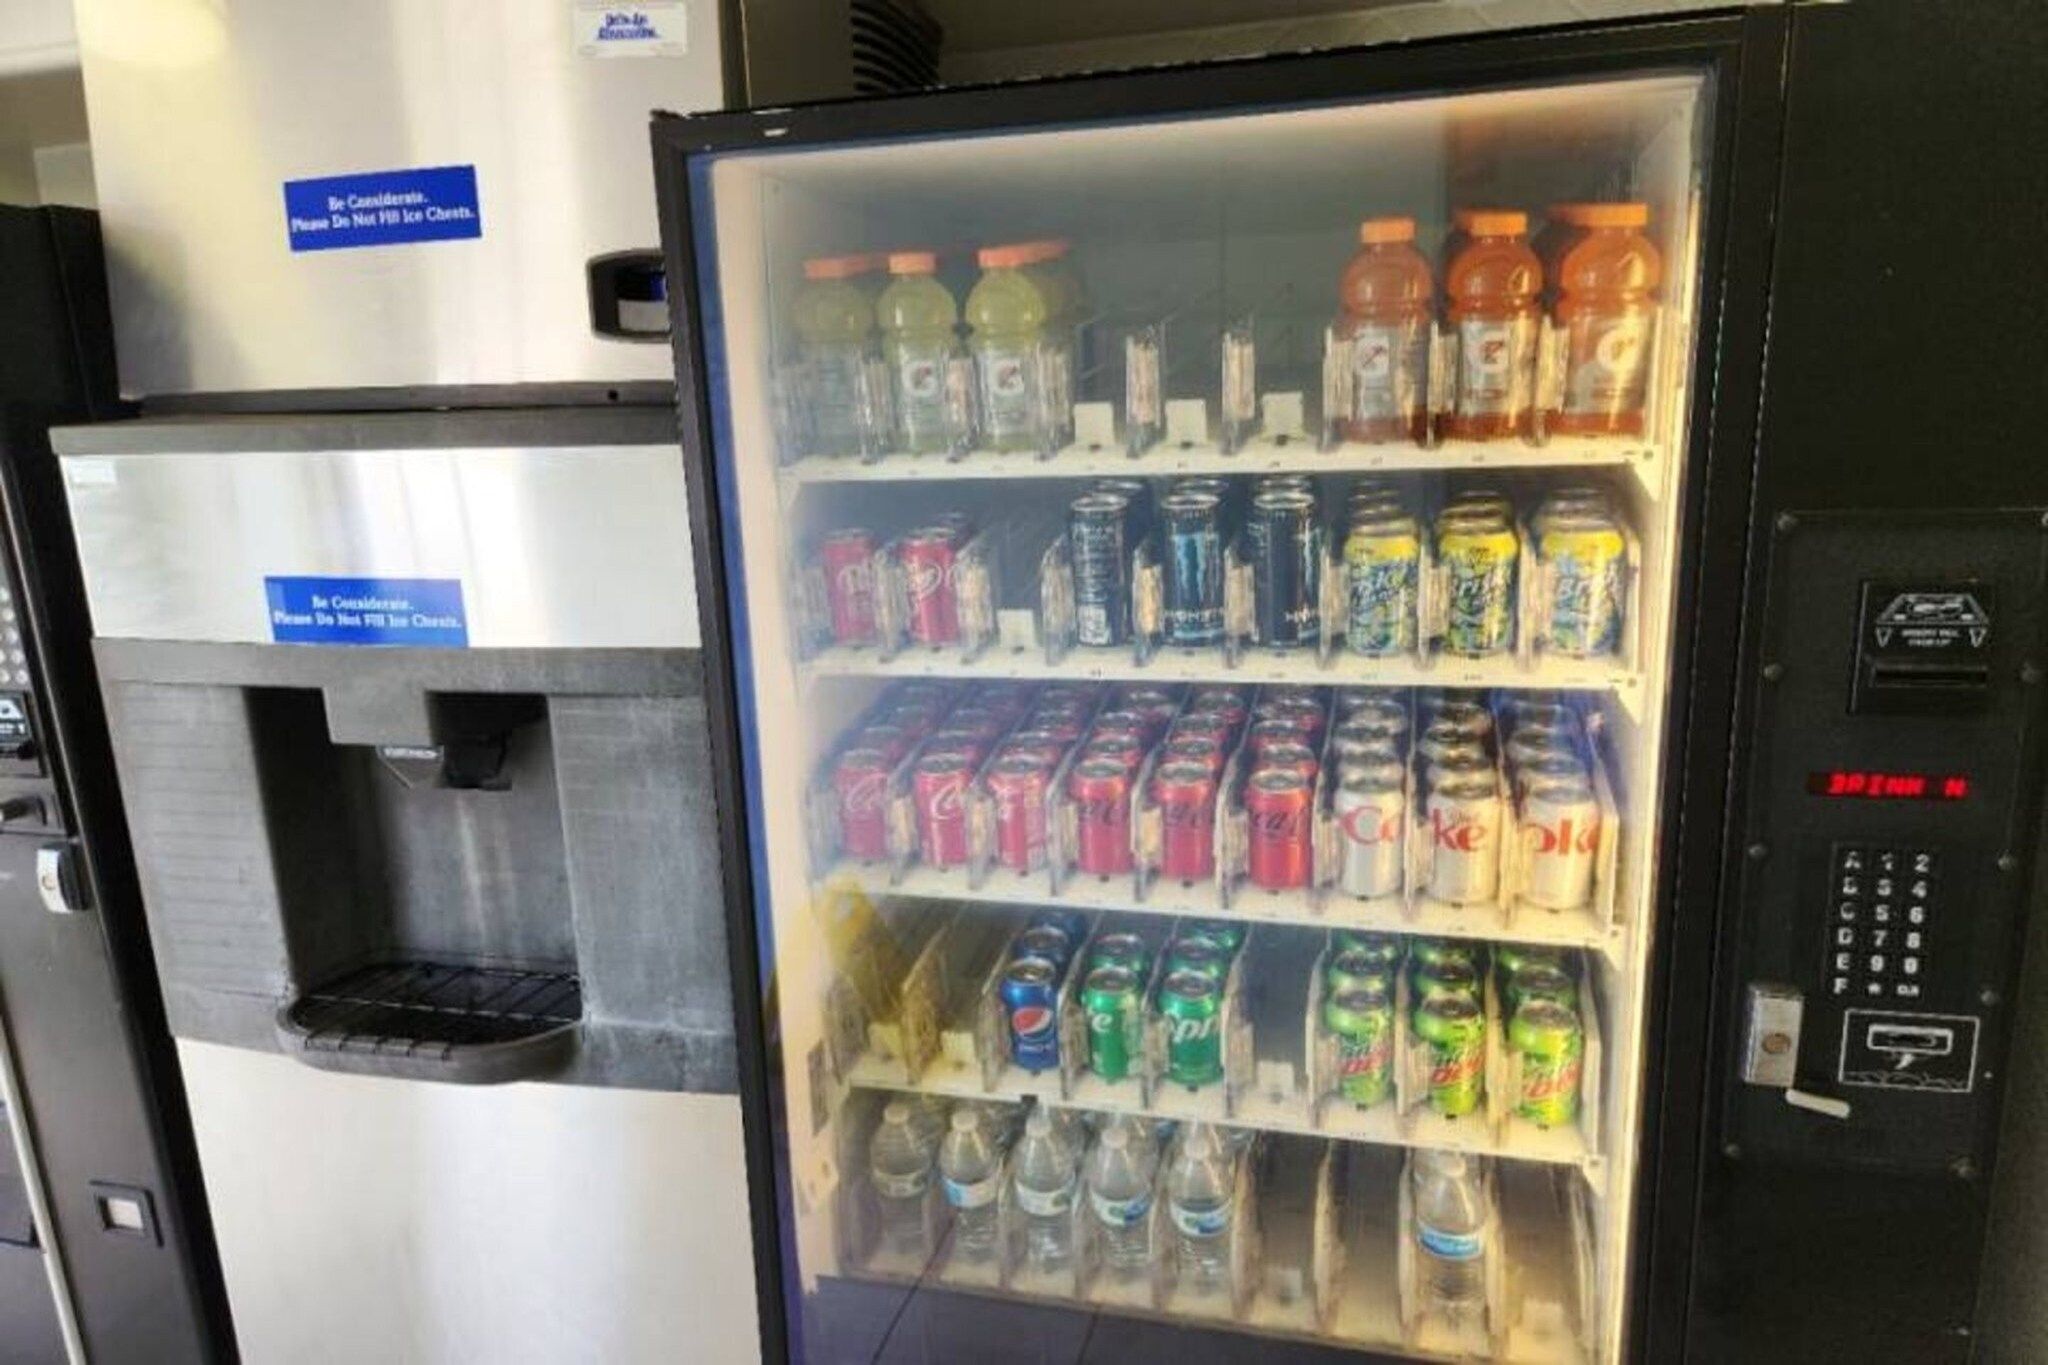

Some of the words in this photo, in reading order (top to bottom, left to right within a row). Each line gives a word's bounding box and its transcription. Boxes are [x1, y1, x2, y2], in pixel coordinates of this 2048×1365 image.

[328, 196, 345, 212] Be
[291, 217, 329, 233] Please
[332, 214, 350, 229] Do
[353, 212, 376, 227] Not
[379, 209, 400, 225] Fill
[403, 207, 423, 223] Ice
[312, 595, 328, 609] Be
[274, 611, 313, 626] Please
[316, 611, 334, 626] Do
[337, 612, 362, 627] Not
[364, 613, 385, 627] Fill
[389, 613, 409, 628] Ice
[1914, 853, 1930, 873] 2
[1840, 902, 1855, 920] C
[1876, 904, 1890, 921] 5
[1909, 906, 1924, 924] 6
[1837, 927, 1853, 945] D
[1874, 930, 1887, 947] 7
[1906, 932, 1921, 949] 8
[1836, 952, 1850, 970] E
[1870, 954, 1884, 972] 9
[1833, 977, 1848, 994] F
